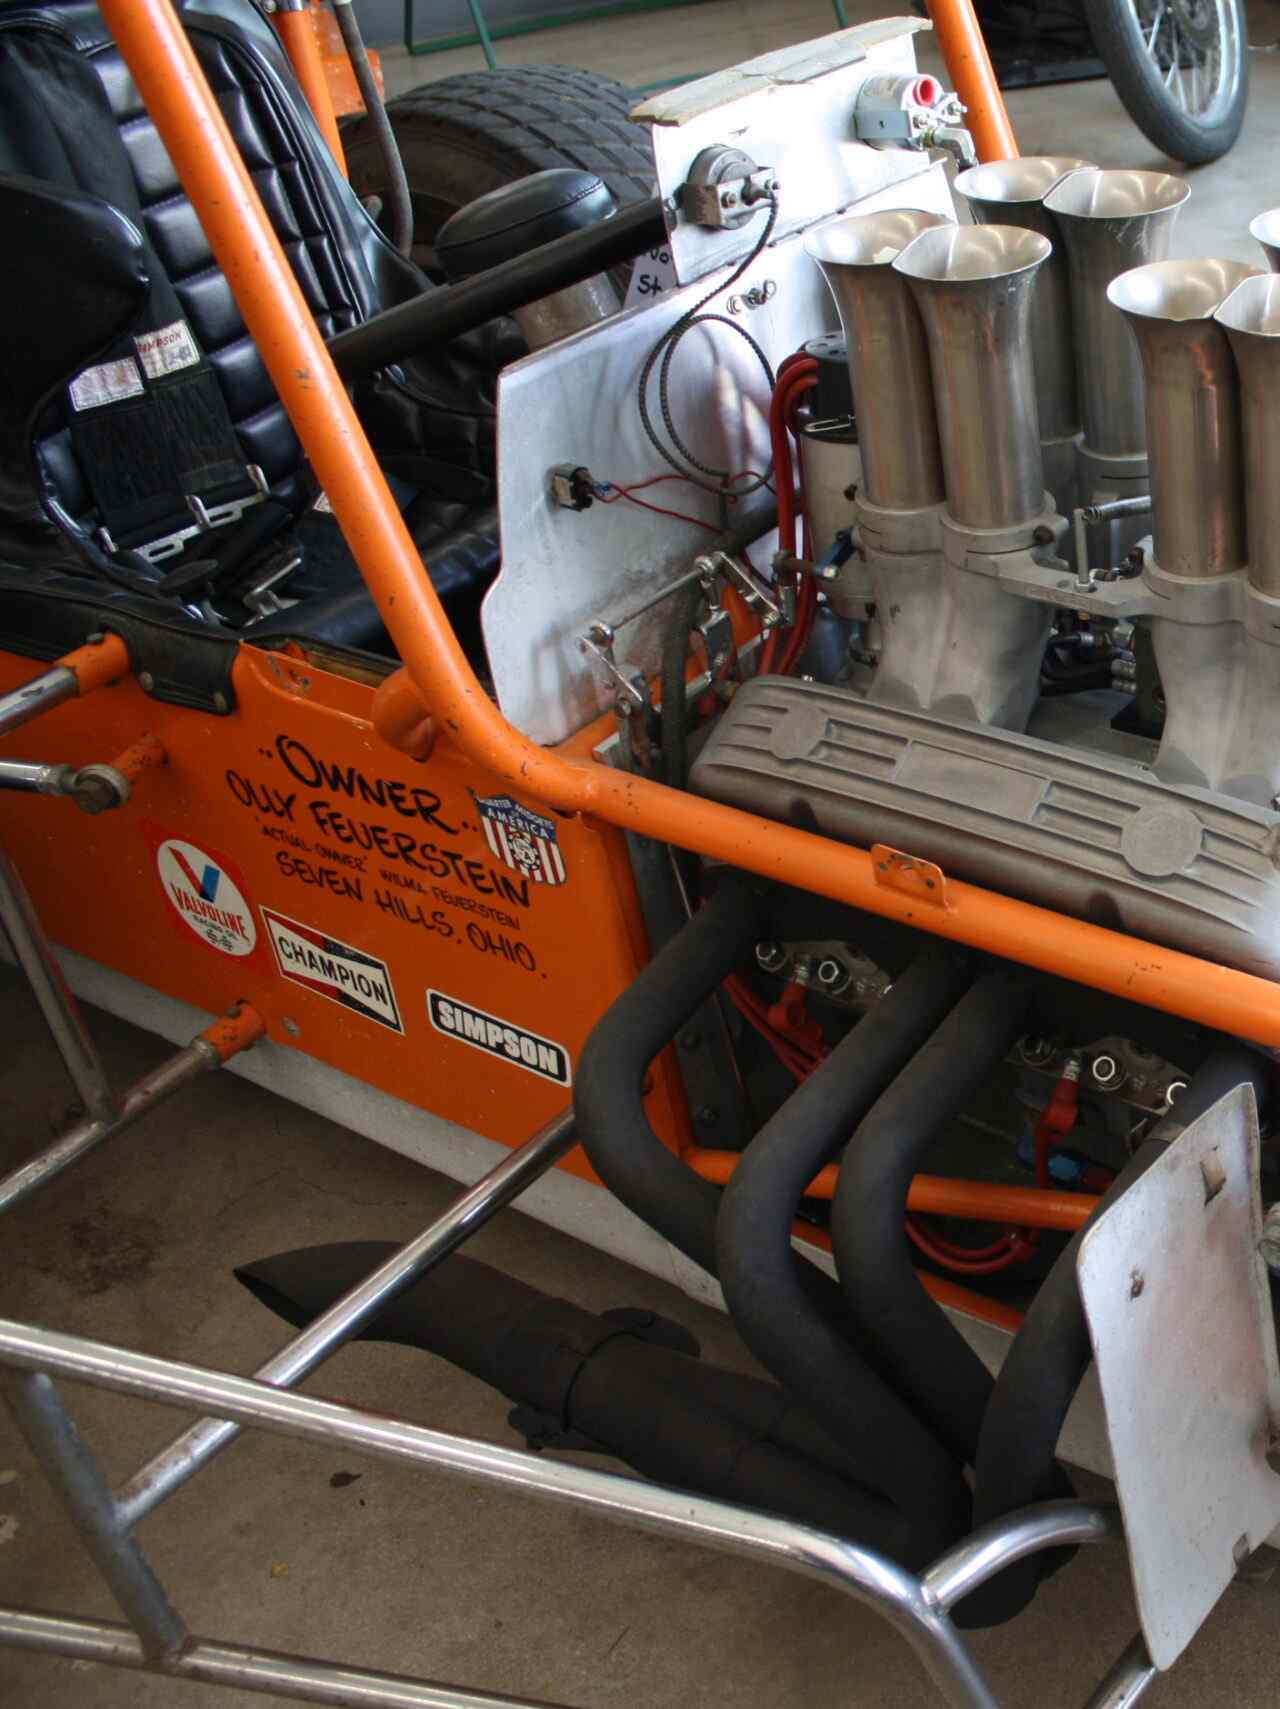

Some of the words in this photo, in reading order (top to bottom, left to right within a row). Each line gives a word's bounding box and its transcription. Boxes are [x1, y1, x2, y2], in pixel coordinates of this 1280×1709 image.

[226, 770, 296, 822] OLLY
[309, 801, 530, 908] FEUERSTEIN
[486, 807, 551, 841] AMERICA
[274, 851, 363, 902] SEVEN
[169, 881, 250, 943] VALVOLINE
[278, 936, 389, 1006] CHAMPION
[438, 1000, 559, 1075] SIMPSON
